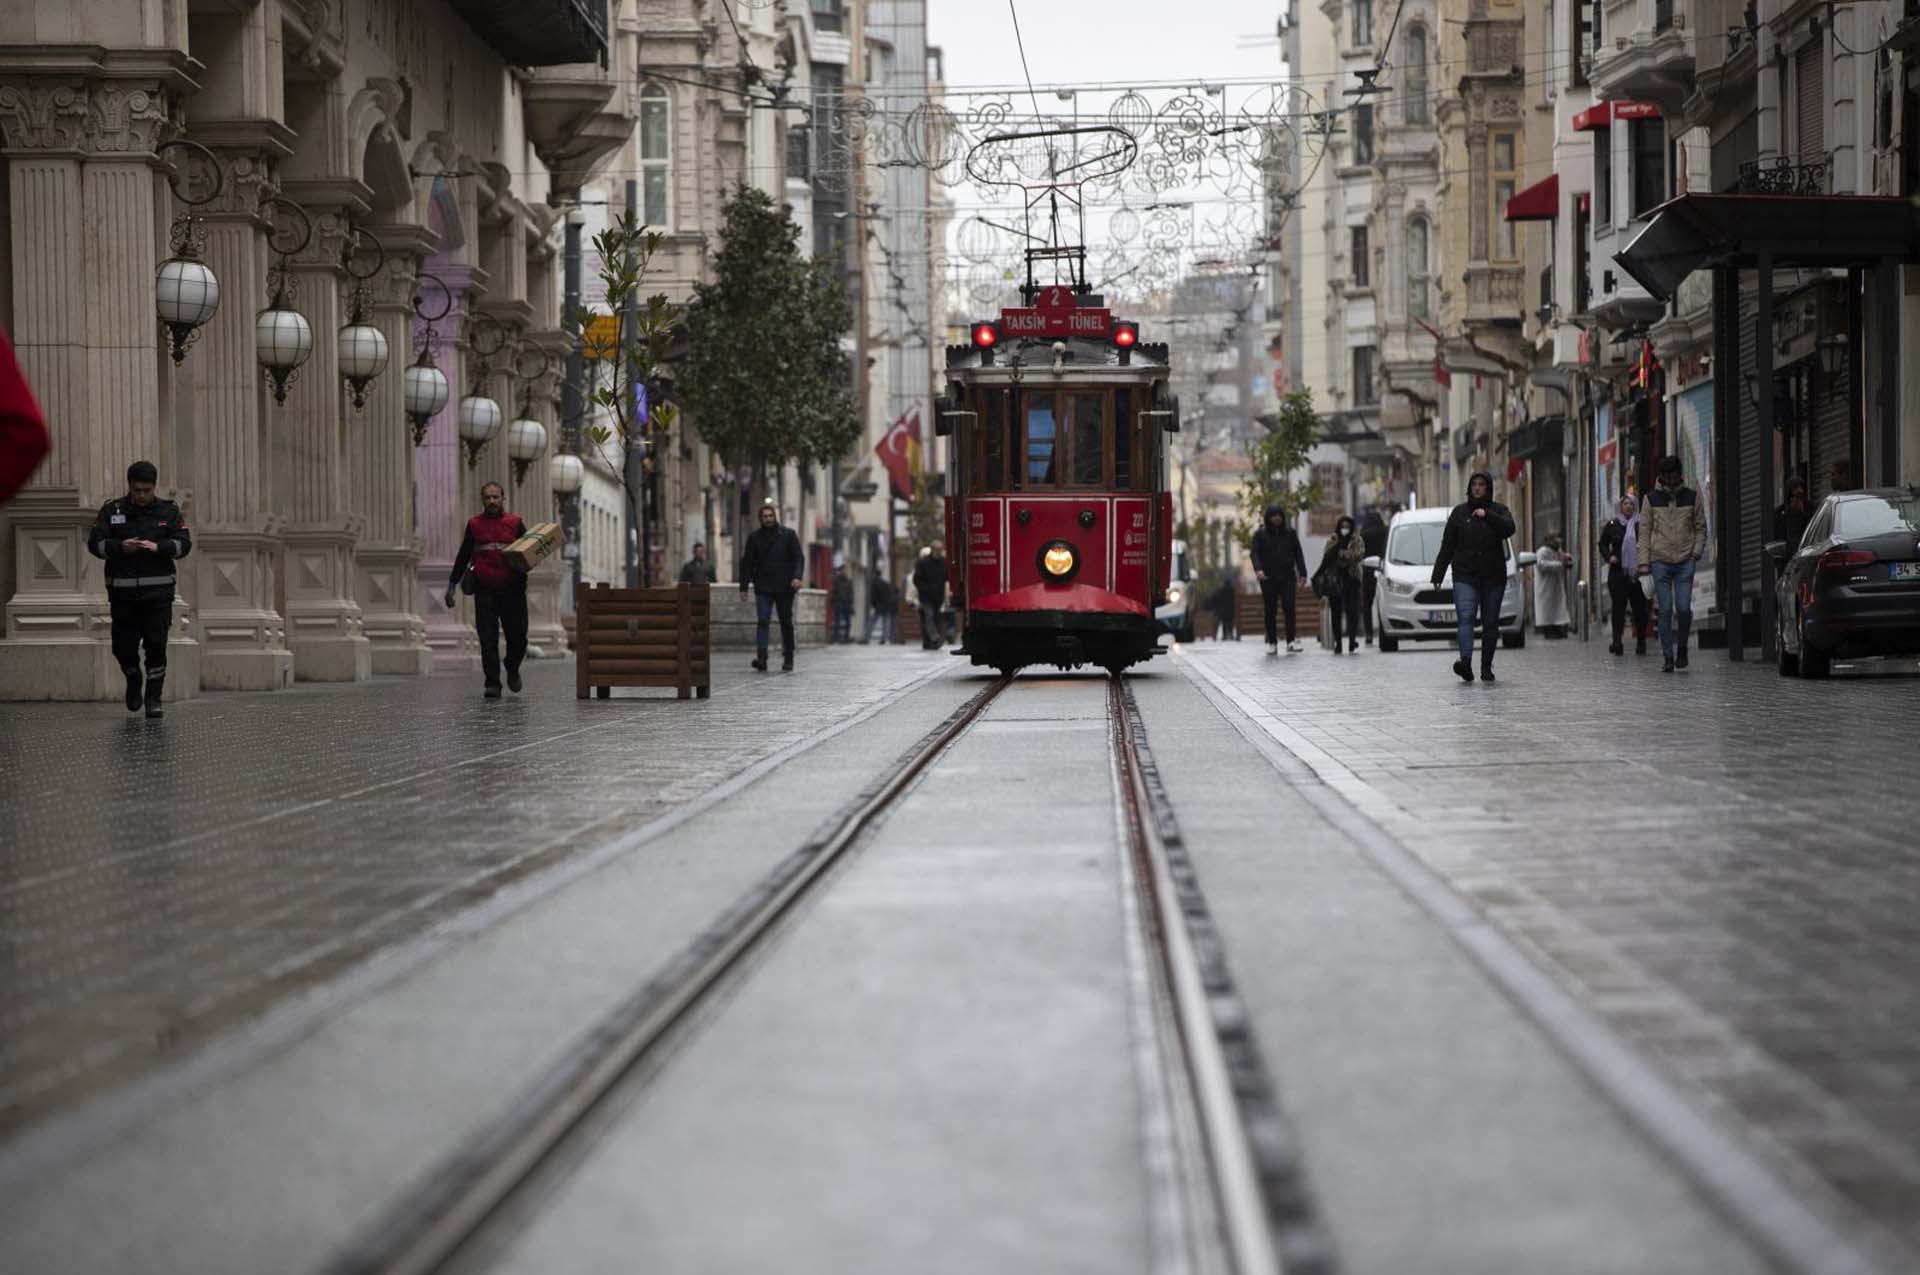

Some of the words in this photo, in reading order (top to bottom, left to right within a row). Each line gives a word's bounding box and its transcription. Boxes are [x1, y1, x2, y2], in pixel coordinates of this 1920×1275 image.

[1051, 288, 1060, 305] 2
[1006, 311, 1046, 331] TAKSİM
[1069, 311, 1105, 331] TÜNEL
[1897, 563, 1909, 576] 34
